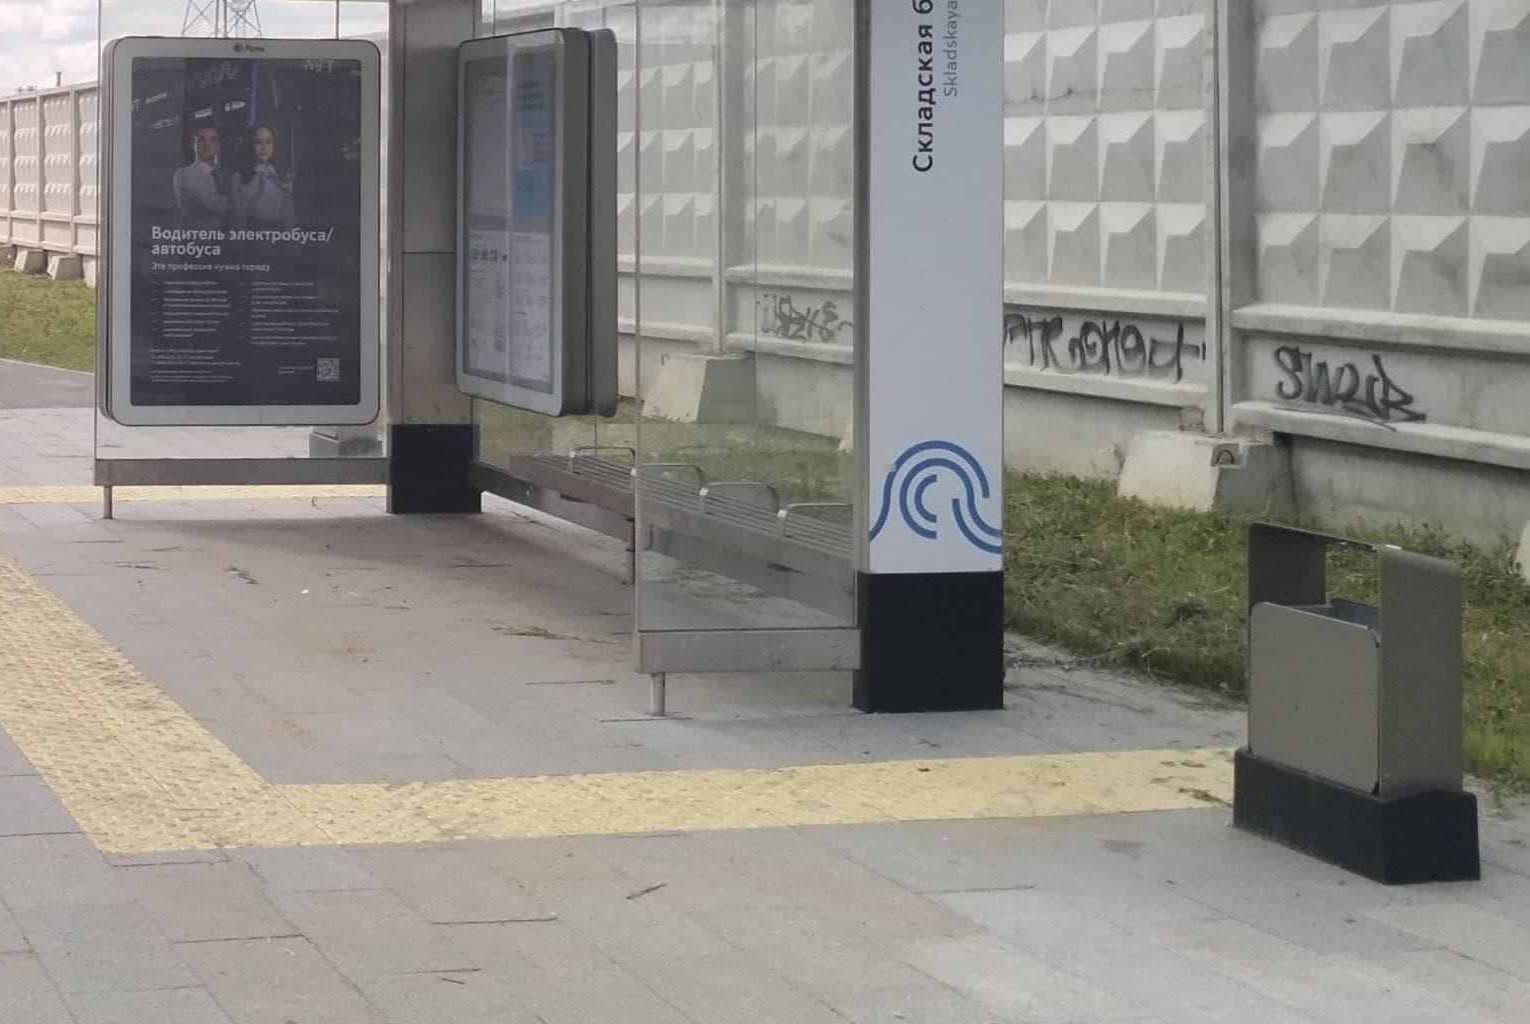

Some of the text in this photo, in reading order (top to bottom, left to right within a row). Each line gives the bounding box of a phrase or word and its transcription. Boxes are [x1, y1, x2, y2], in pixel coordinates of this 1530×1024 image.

[943, 0, 961, 97] Skladskaya
[912, 24, 936, 172] Складская
[151, 226, 335, 244] Водитель электробуса/
[151, 242, 221, 258] автобуса
[151, 261, 166, 271] Эта
[167, 262, 212, 273] профессия
